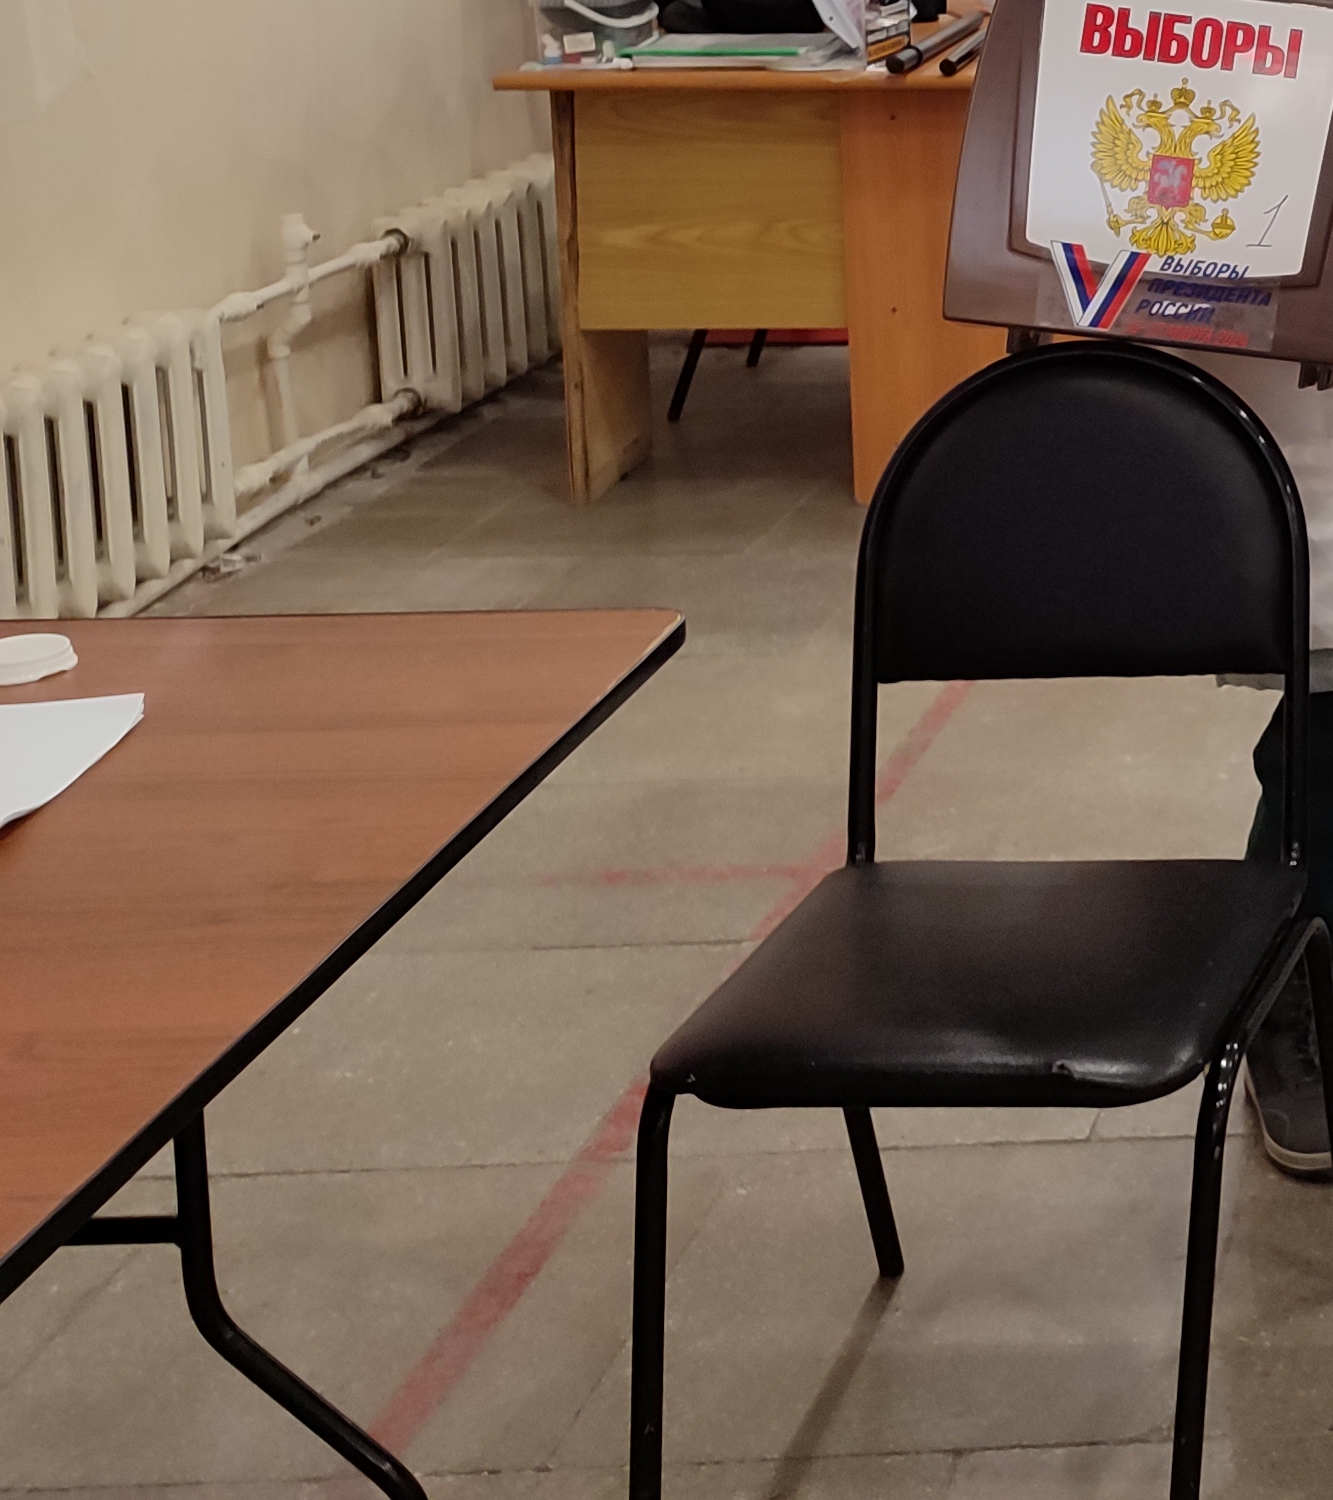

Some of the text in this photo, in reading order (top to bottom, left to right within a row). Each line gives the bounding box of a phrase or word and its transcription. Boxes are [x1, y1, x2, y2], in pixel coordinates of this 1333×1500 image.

[1080, 3, 1303, 79] ВЫБОРЫ
[1246, 194, 1289, 247] 1
[1159, 255, 1250, 281] ВЫБОРЫ
[1147, 277, 1273, 308] ПРЕЗИДЕНТА
[1135, 299, 1216, 324] РОССИИ
